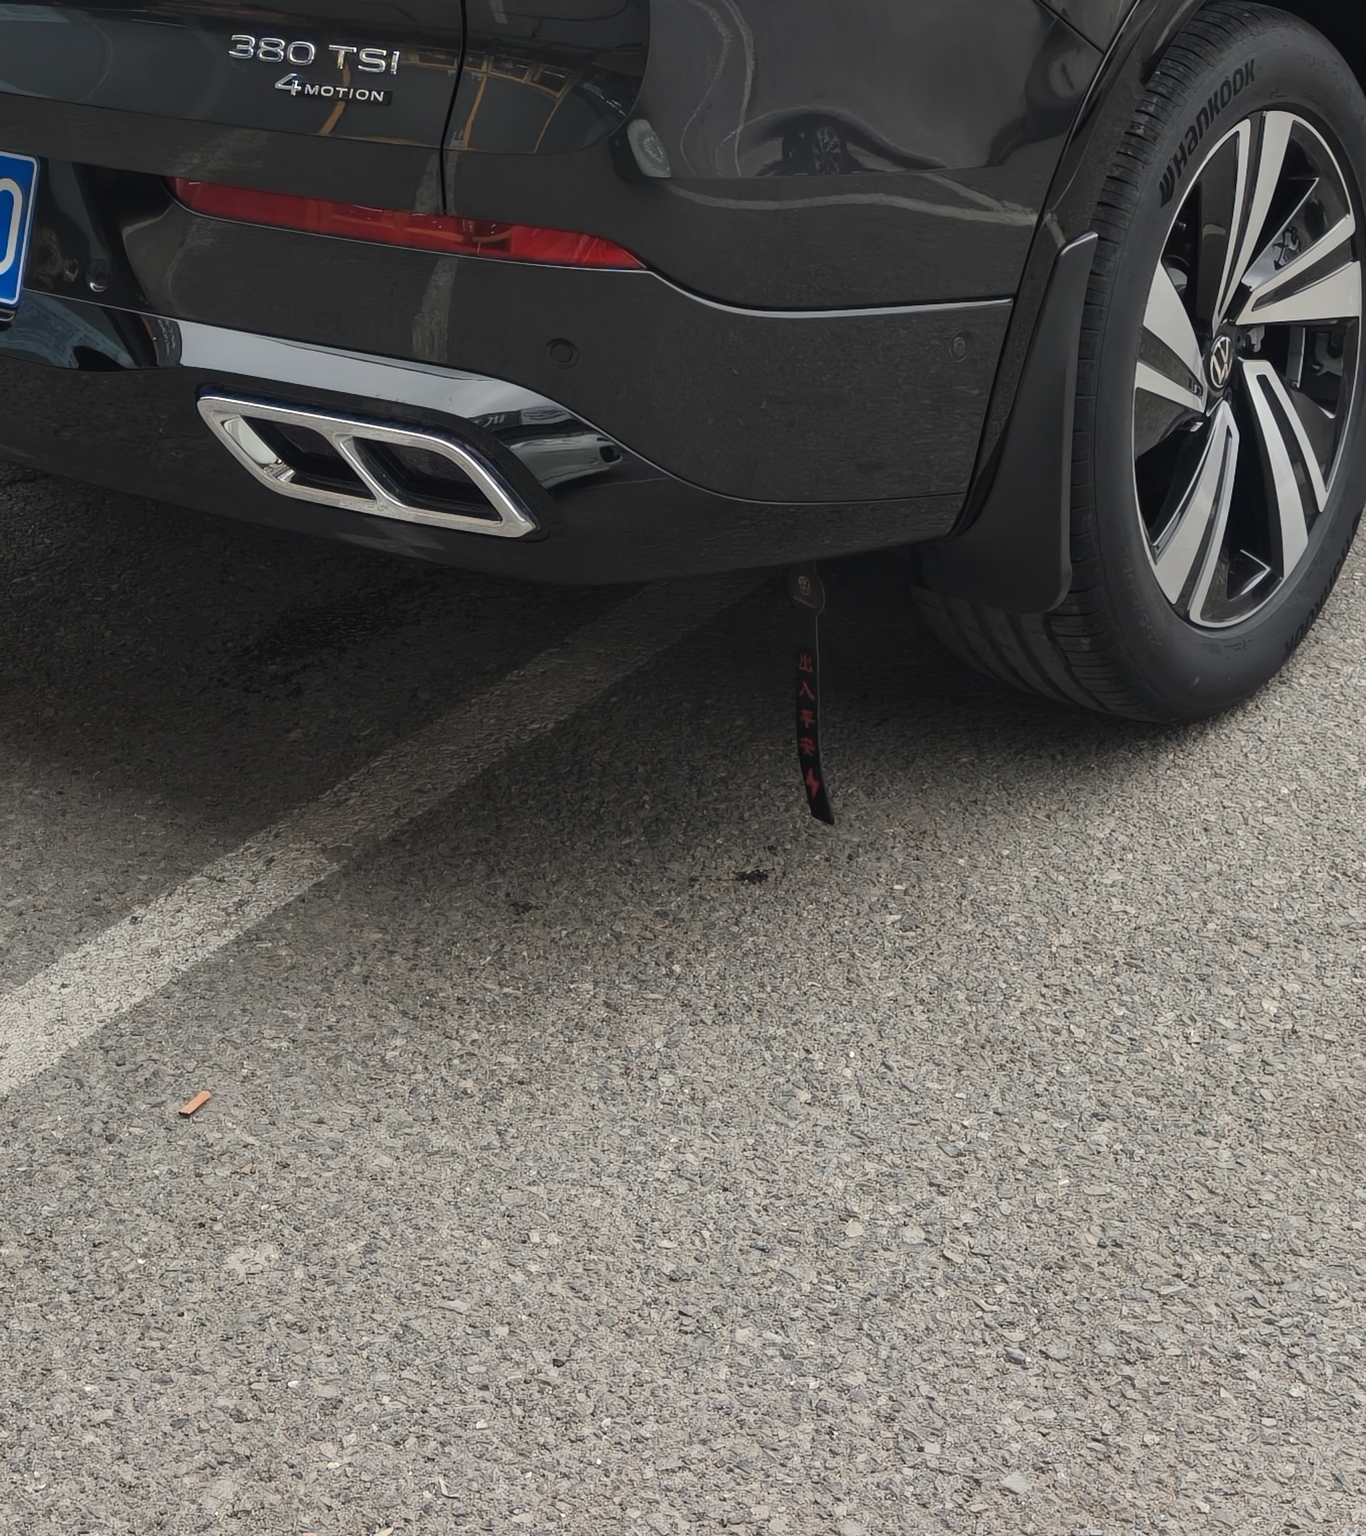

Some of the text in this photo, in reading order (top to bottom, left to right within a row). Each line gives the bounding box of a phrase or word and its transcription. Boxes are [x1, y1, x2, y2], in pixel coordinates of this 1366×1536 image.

[228, 34, 401, 76] 380 TSI
[274, 72, 386, 103] 4MOTION
